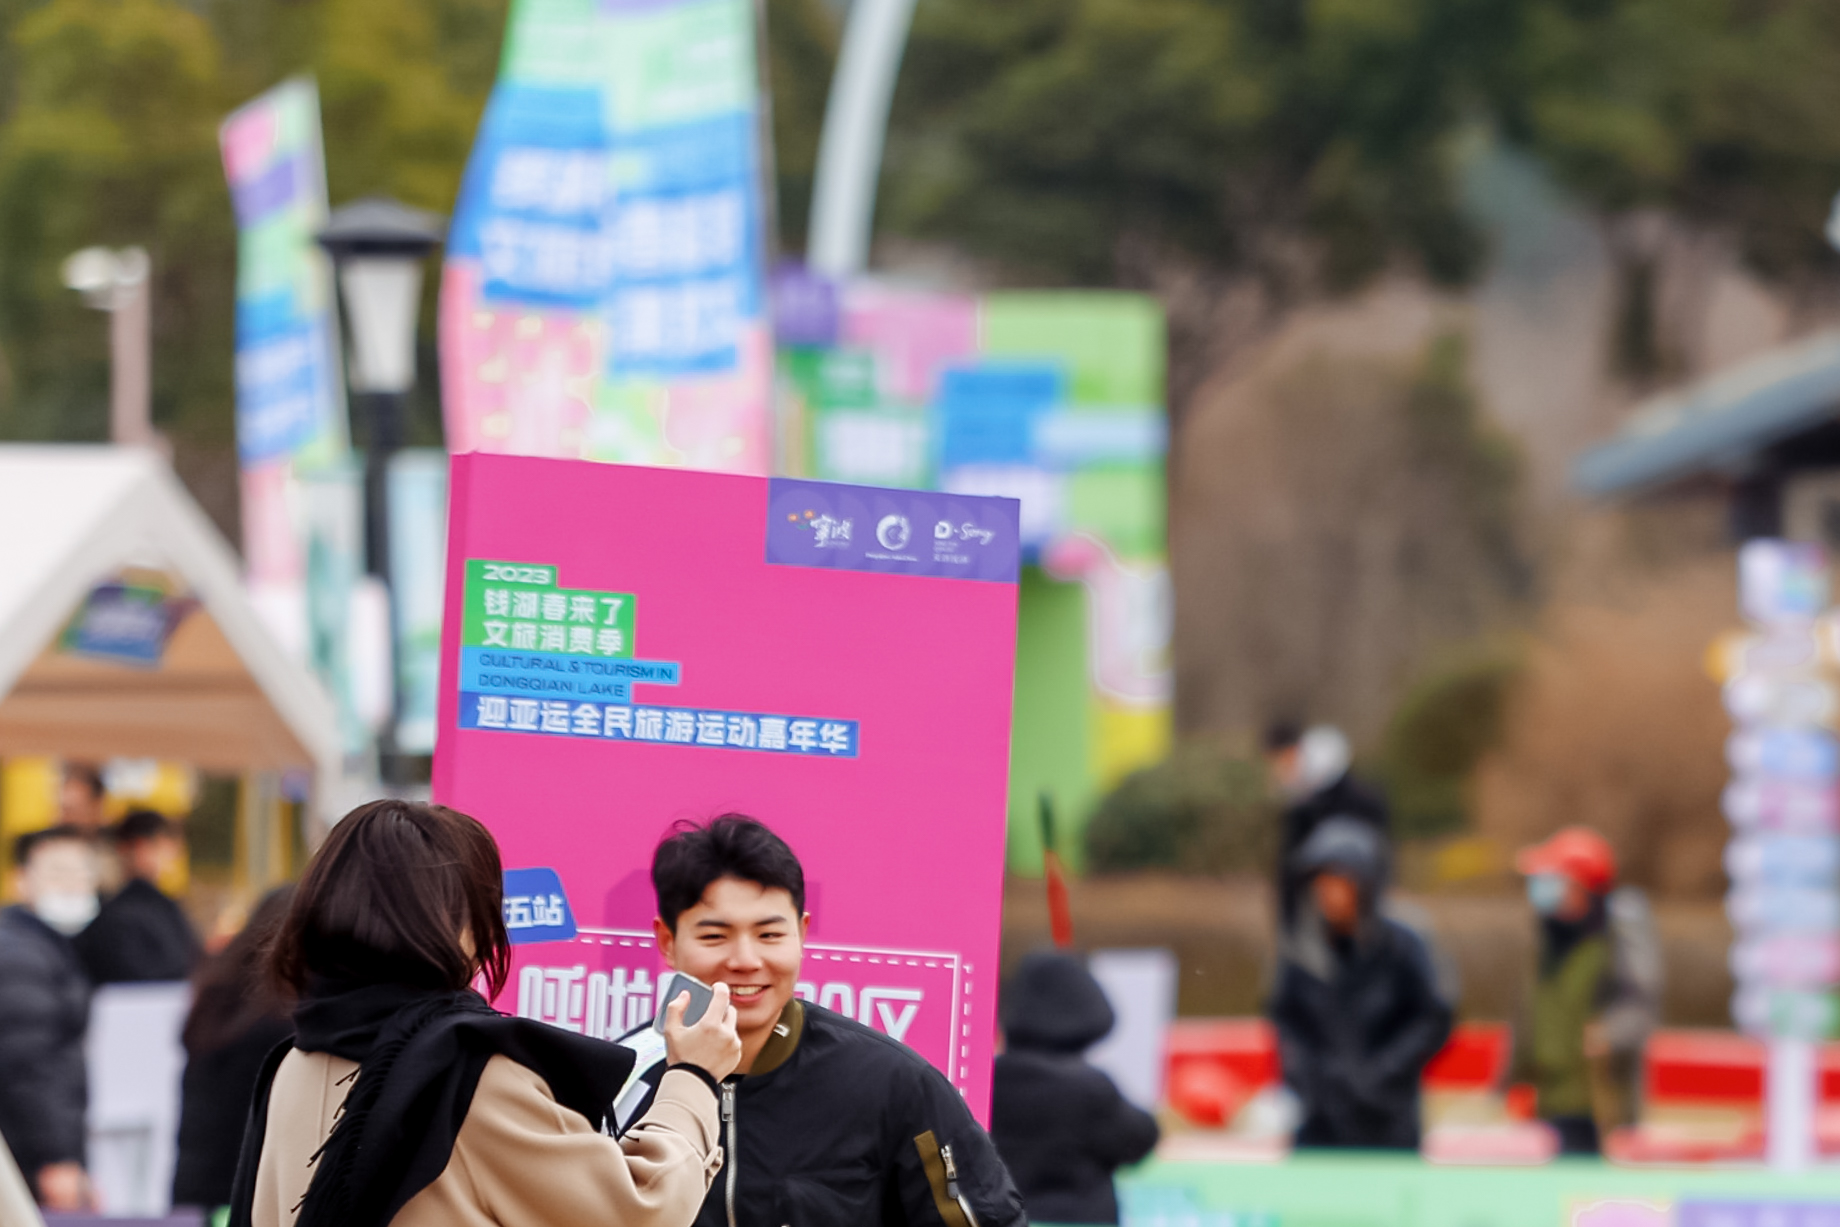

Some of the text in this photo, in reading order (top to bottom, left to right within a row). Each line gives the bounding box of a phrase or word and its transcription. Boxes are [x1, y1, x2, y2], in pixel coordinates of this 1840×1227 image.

[482, 564, 551, 584] 2023
[484, 588, 624, 625] 钱湖春来了
[482, 620, 622, 655] 文旅消费季
[479, 654, 673, 680] CULTURAL & TOURISM IN
[479, 674, 624, 697] DONGQIAN LAKE
[477, 696, 848, 753] 迎亚运全民旅游运动嘉年华
